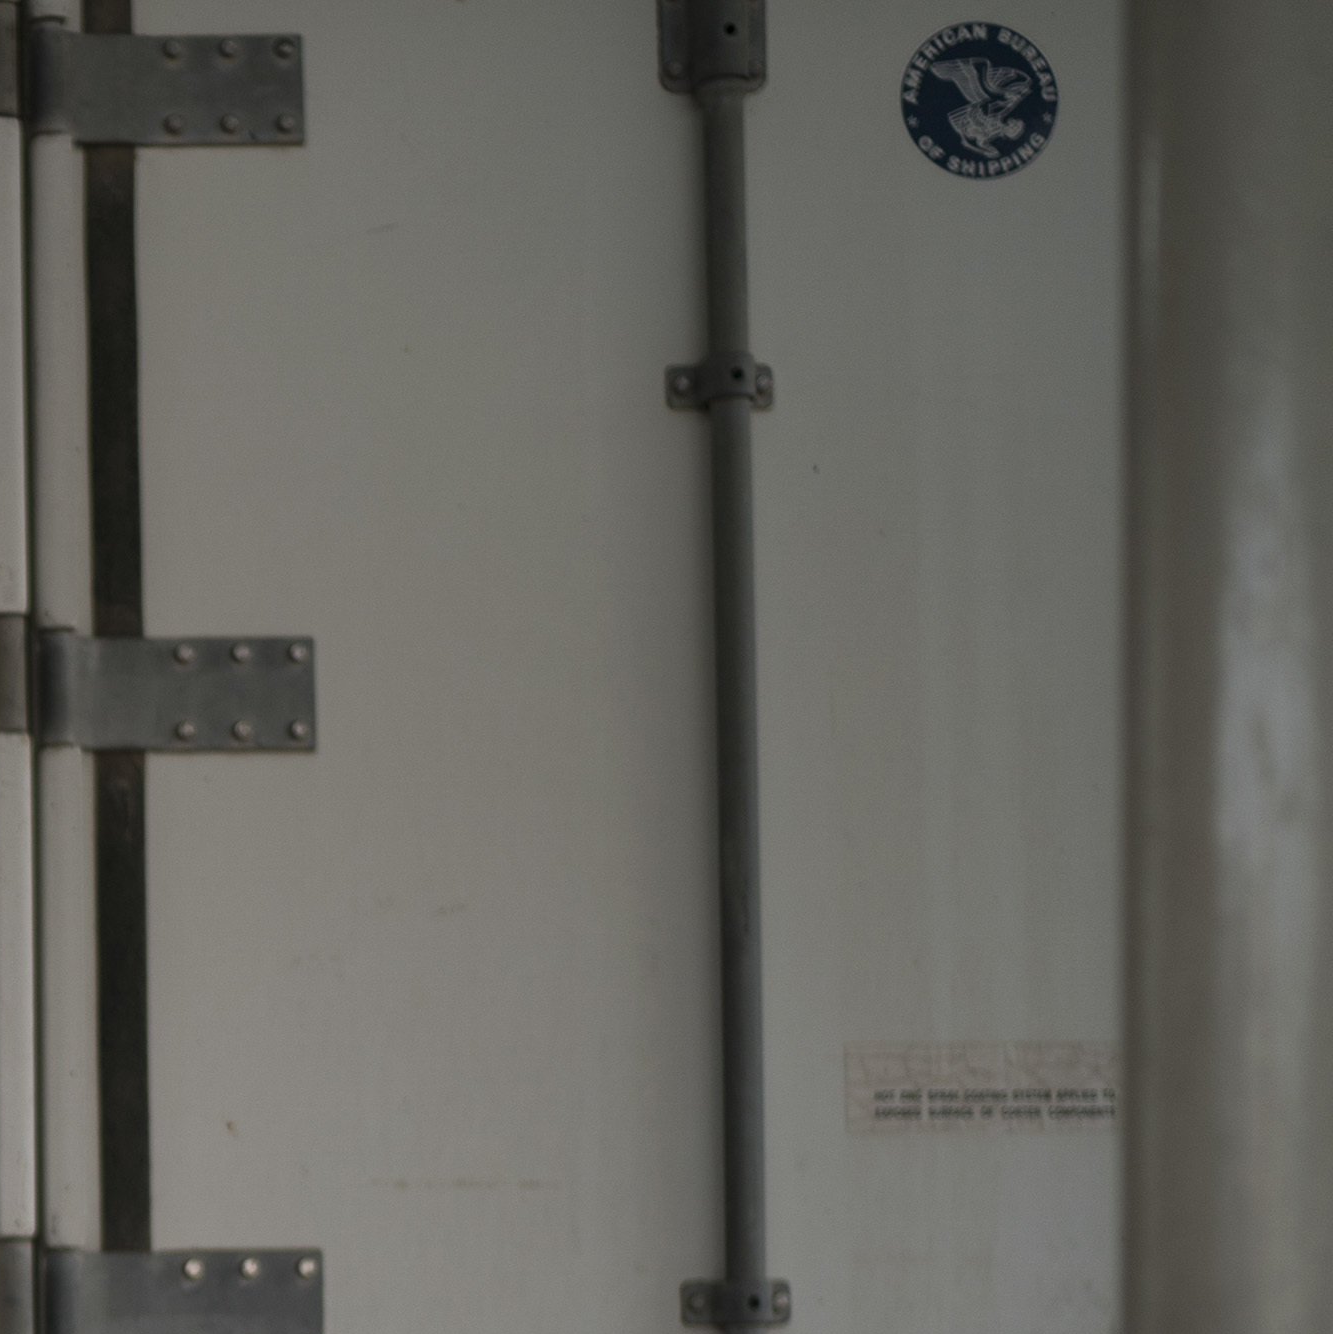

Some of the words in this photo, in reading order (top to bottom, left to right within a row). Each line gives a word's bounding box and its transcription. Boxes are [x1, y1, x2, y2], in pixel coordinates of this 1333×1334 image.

[903, 24, 987, 105] AMERICAN
[998, 29, 1056, 101] BUREAU
[918, 135, 946, 160] OF
[947, 133, 1045, 176] SHIPPING
